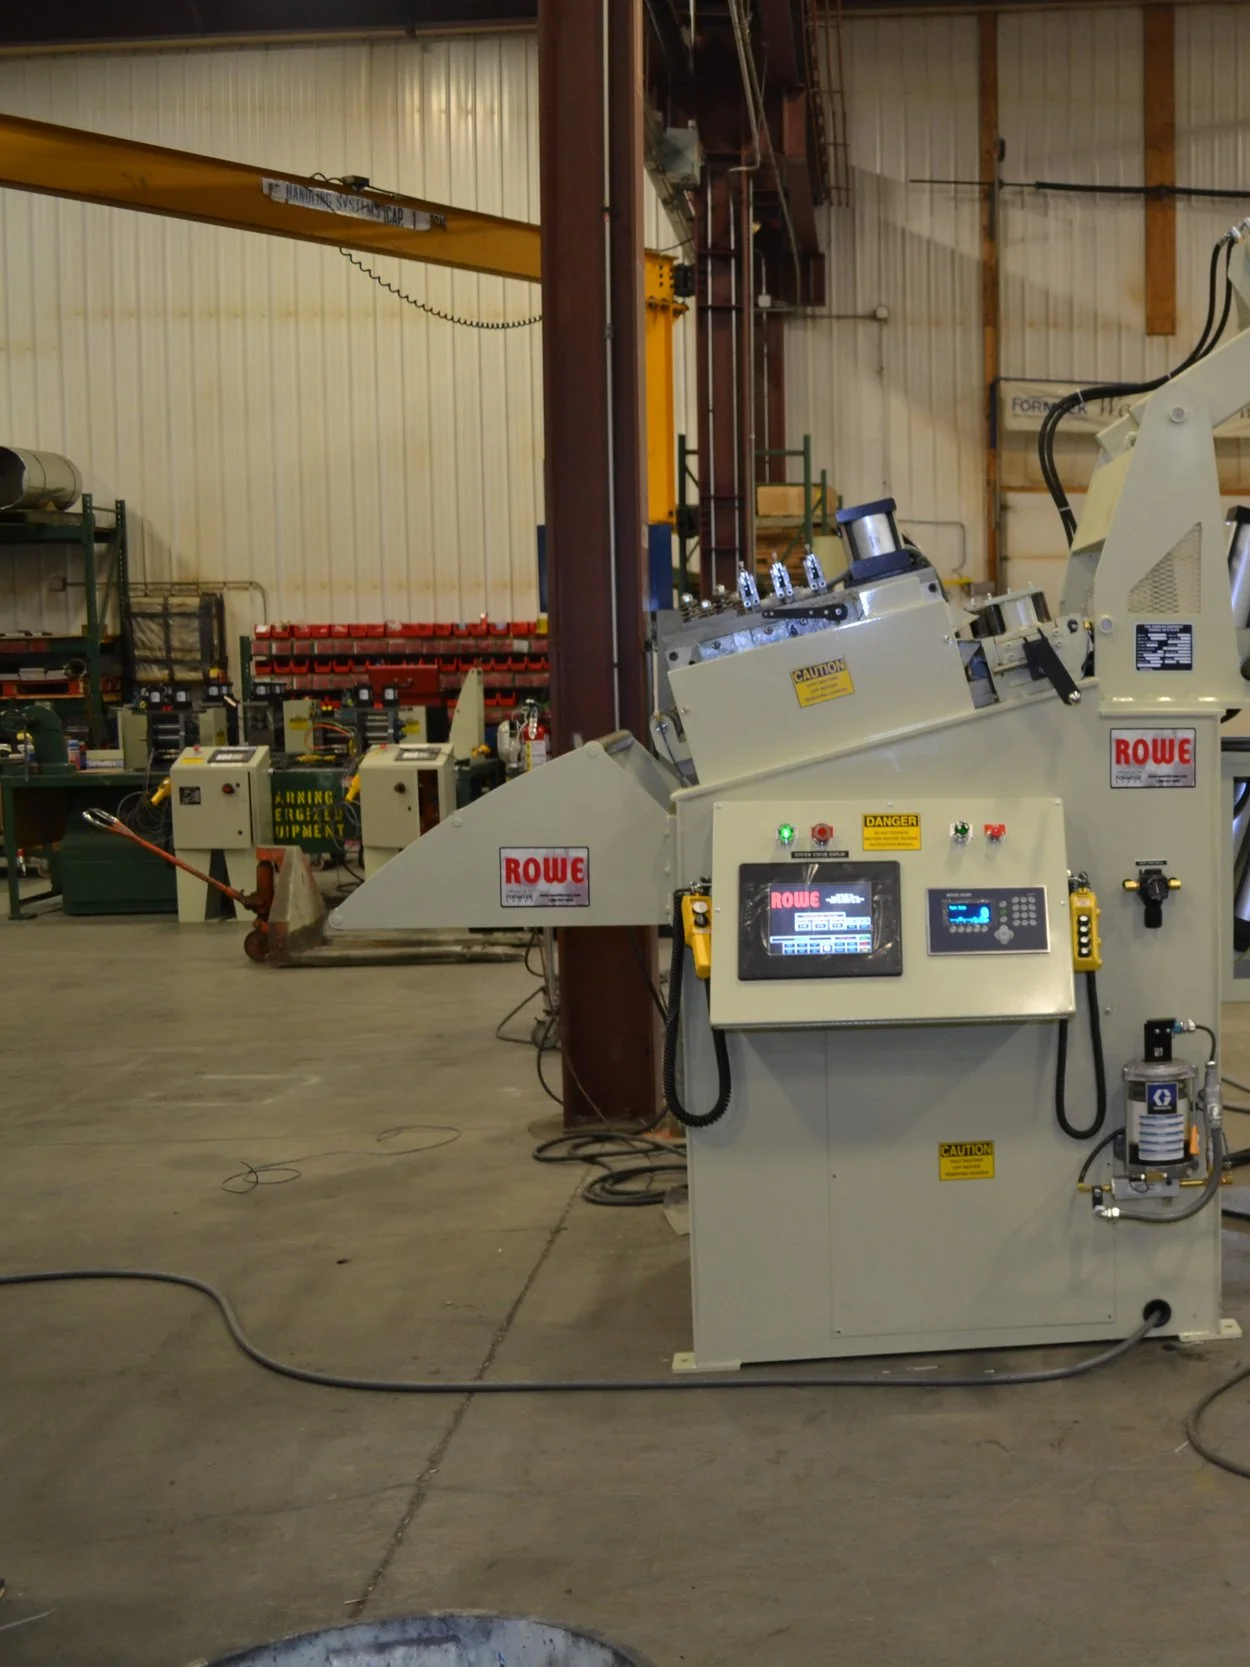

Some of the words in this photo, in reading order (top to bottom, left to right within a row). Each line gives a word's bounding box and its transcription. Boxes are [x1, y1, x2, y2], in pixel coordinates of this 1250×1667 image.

[794, 659, 845, 683] CAUTION
[1115, 738, 1192, 765] ROWE
[275, 791, 333, 804] ARNING
[866, 816, 917, 826] DANGER
[275, 824, 344, 838] UIPMENT
[504, 857, 584, 884] ROWE
[771, 891, 820, 908] ROWE
[942, 1143, 991, 1156] CAUTION
